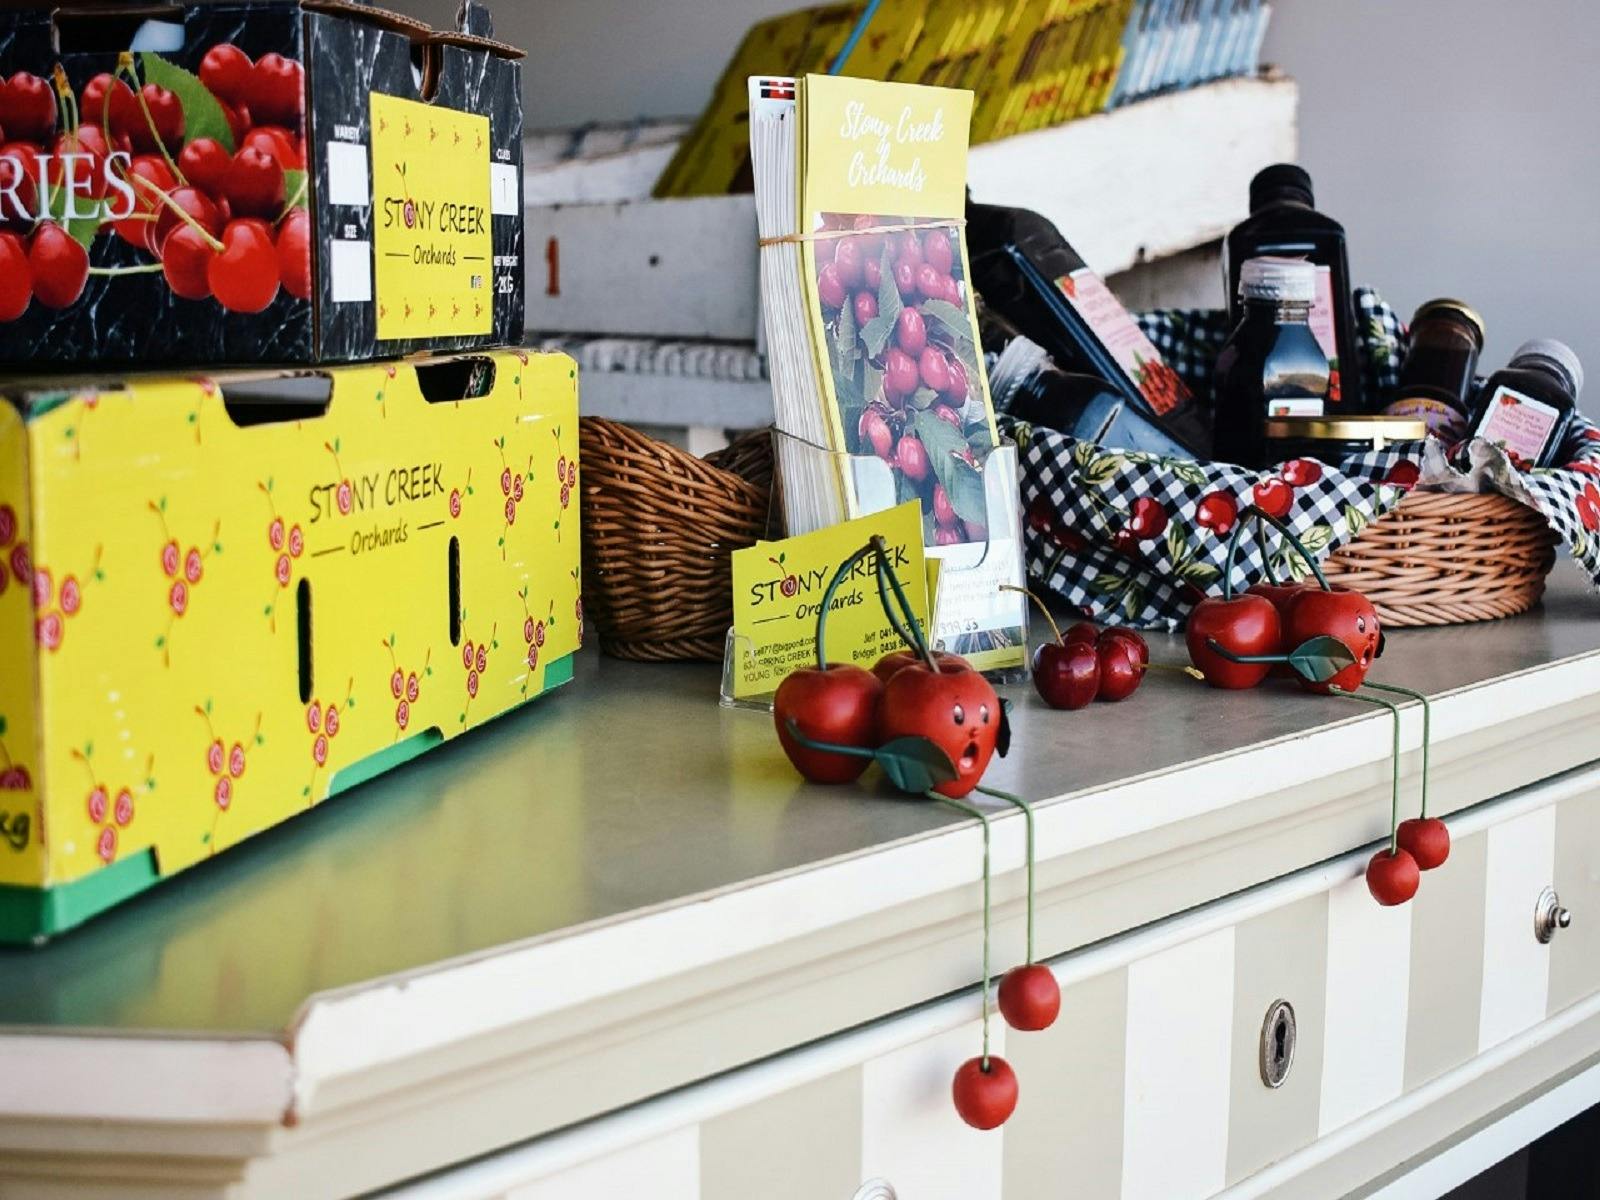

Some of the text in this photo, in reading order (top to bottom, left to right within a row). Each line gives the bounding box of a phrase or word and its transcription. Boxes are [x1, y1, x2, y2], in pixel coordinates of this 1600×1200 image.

[840, 100, 945, 148] Stony Creek
[847, 141, 927, 192] Orchards
[384, 197, 485, 234] STONY CREEK
[413, 243, 456, 266] Orchards
[309, 462, 445, 524] STONY CREEK
[351, 517, 408, 555] Orchards
[750, 566, 829, 606] STONY
[837, 544, 909, 584] REK
[795, 588, 864, 619] Orcards
[787, 648, 811, 662] CREEK
[743, 669, 770, 683] YOUNG
